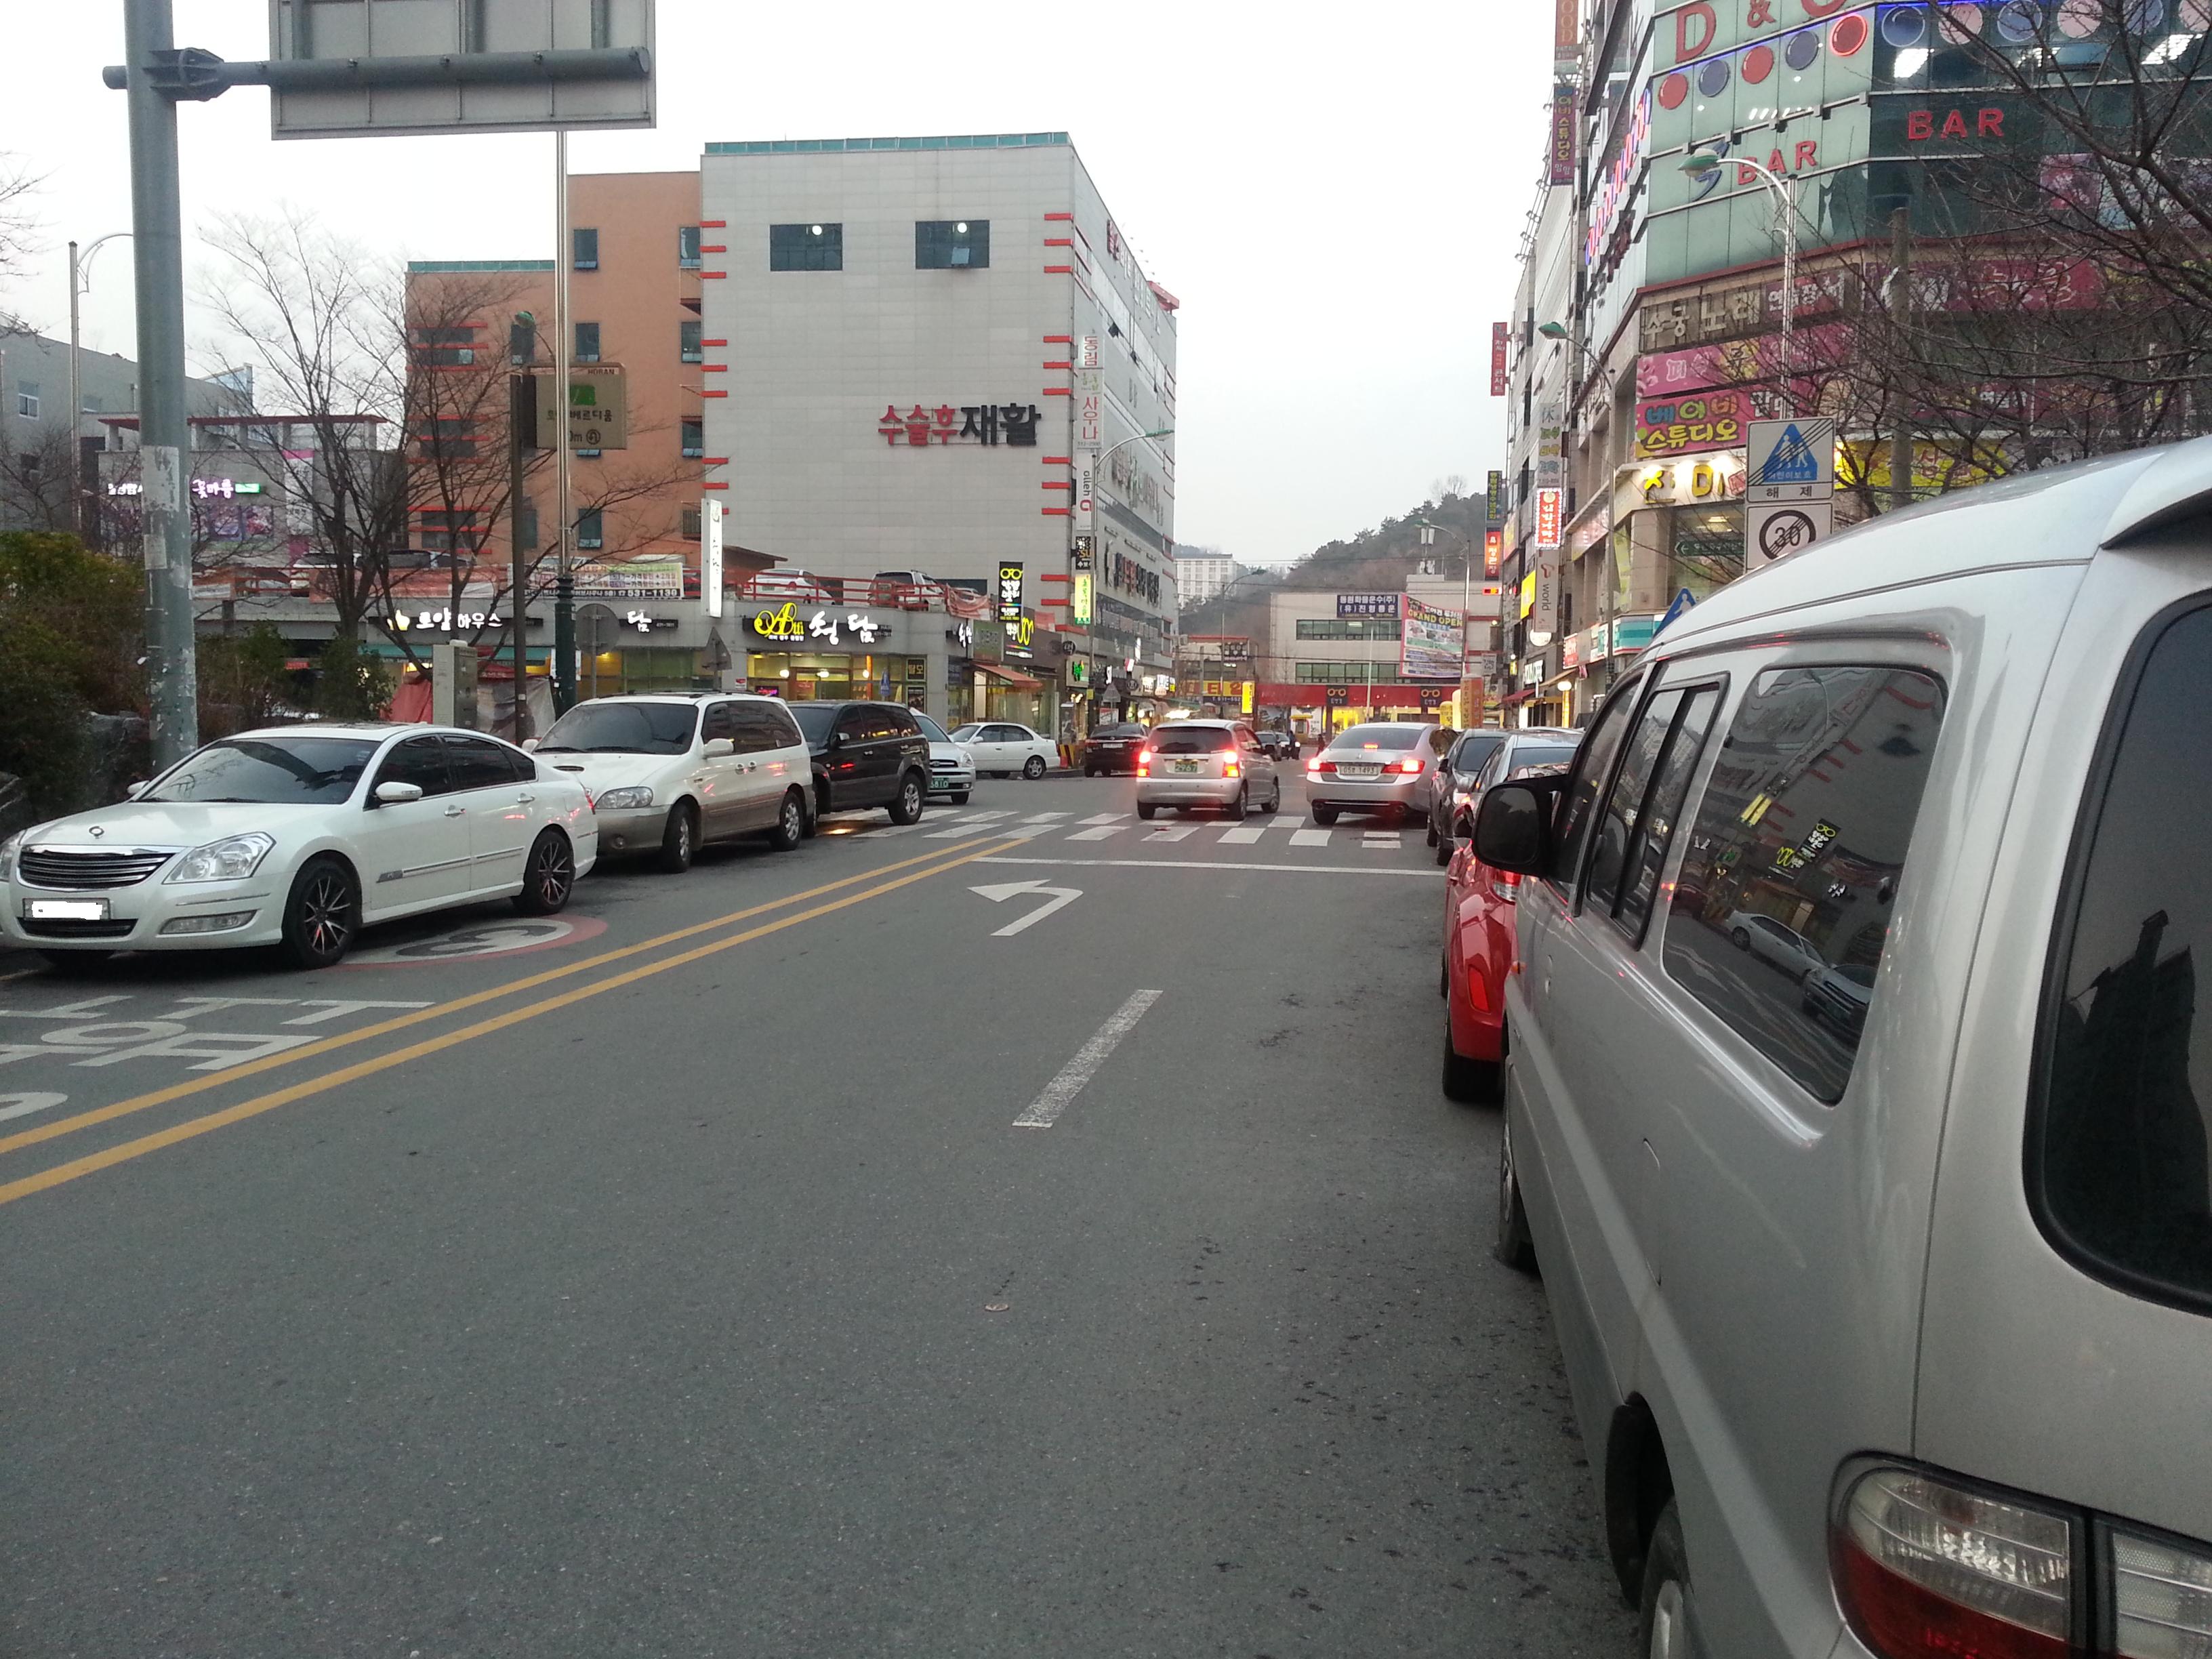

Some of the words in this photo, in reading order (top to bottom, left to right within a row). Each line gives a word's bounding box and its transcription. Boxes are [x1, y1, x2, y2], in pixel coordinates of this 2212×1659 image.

[1908, 108, 2005, 140] BAR
[1737, 140, 1818, 186] BAR
[546, 409, 613, 422] 호베르디움
[1082, 396, 1099, 440] 사우나
[1645, 394, 1738, 425] 베이비
[1644, 417, 1739, 449] 스튜디오
[1082, 470, 1092, 496] olleh
[1767, 470, 1811, 480] 어린이보호
[1774, 526, 1801, 547] 30
[628, 589, 677, 597] 531-1130
[1542, 583, 1552, 611] world
[416, 607, 451, 631] 로얄
[457, 613, 503, 629] 하우스
[1408, 609, 1437, 622] GRAND
[1439, 617, 1463, 627] OPEN
